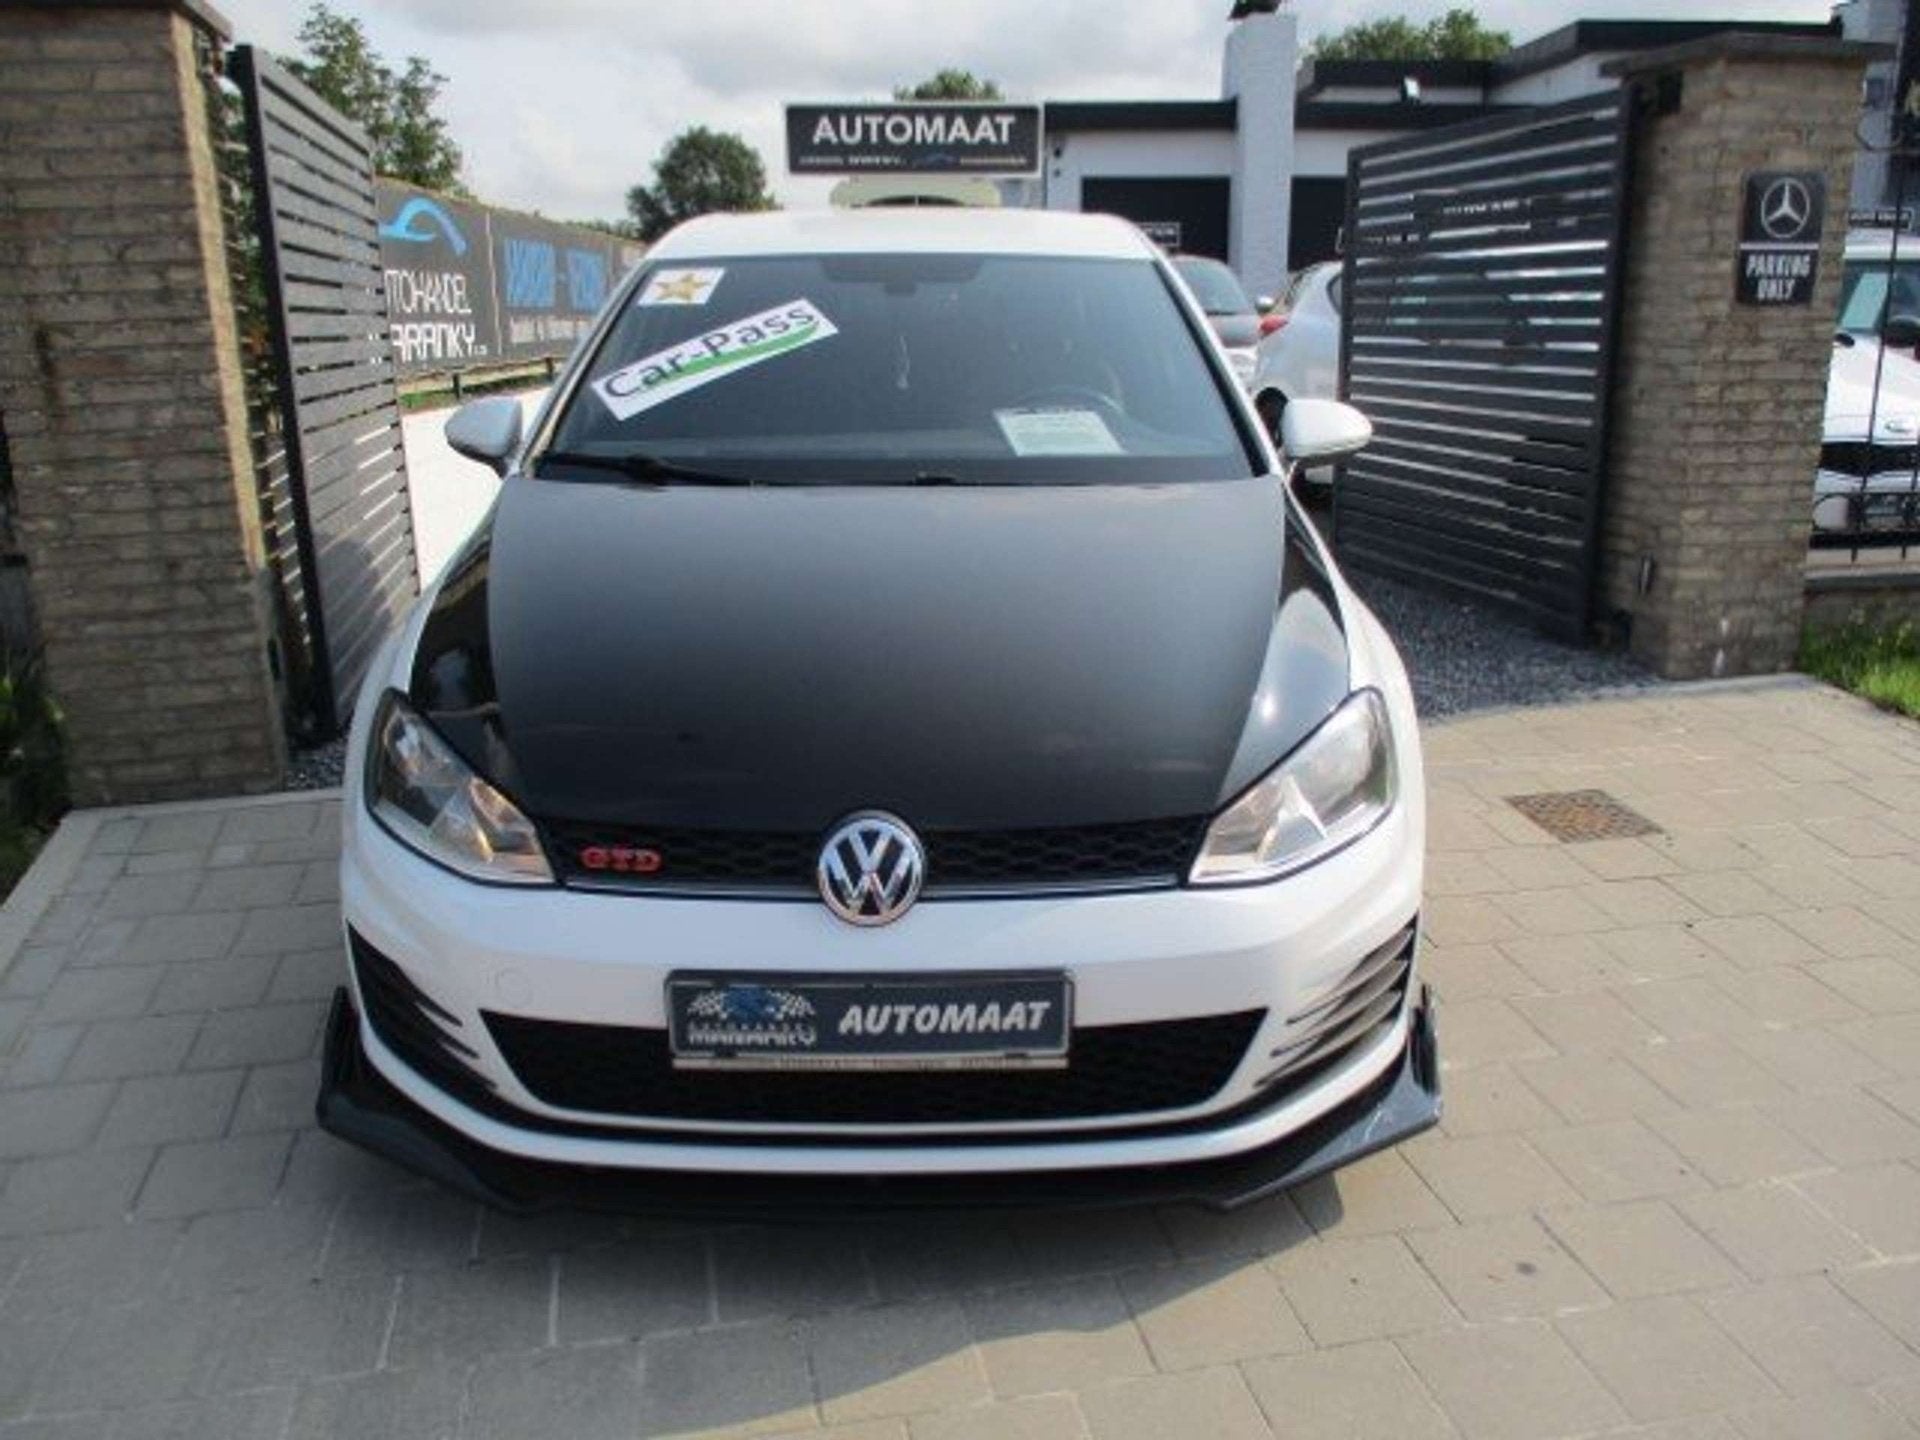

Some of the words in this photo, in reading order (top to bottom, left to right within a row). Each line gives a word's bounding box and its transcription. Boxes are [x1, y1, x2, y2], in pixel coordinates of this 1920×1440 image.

[812, 114, 1016, 145] AUTOMAAT
[1745, 254, 1811, 278] PARKING
[383, 269, 472, 314] TOHANDEL
[1757, 279, 1796, 300] ONLY
[390, 321, 476, 363] ARANKY
[604, 306, 820, 399] Car-Pass
[579, 846, 662, 872] GTD
[838, 1001, 1053, 1035] AUTOMAAT
